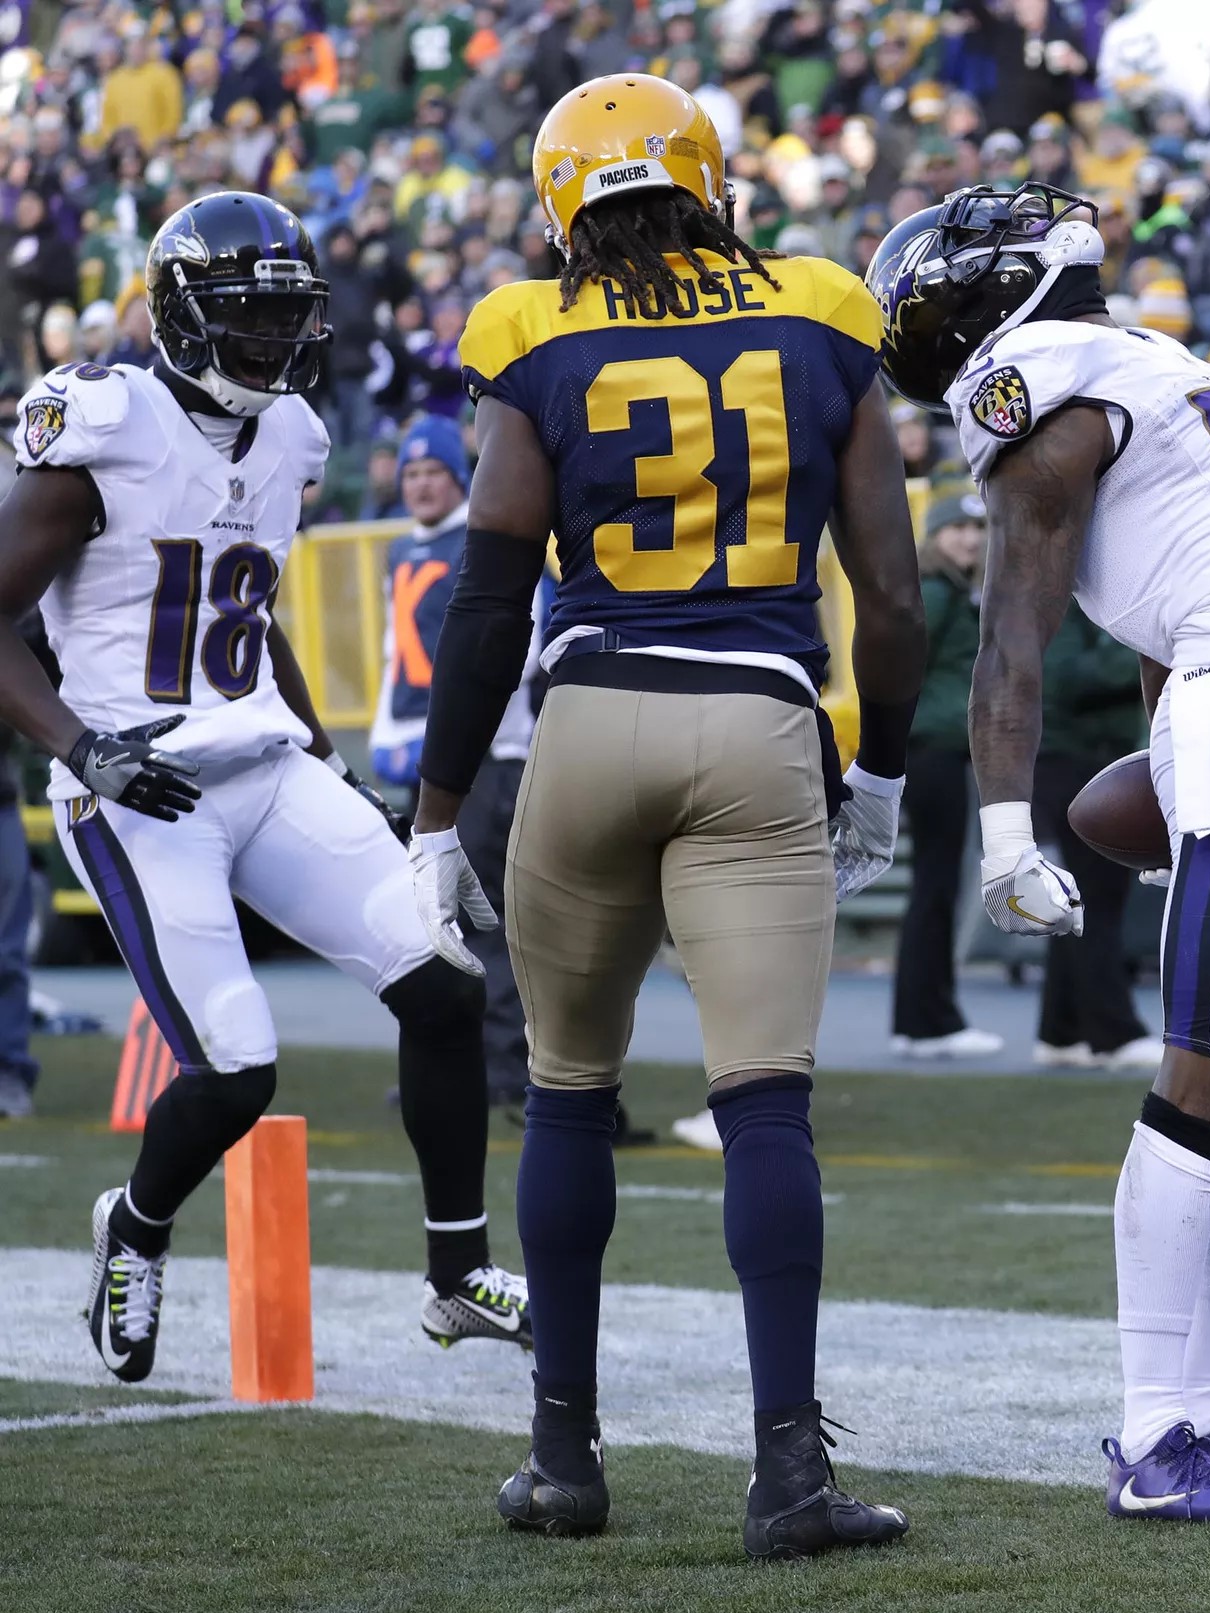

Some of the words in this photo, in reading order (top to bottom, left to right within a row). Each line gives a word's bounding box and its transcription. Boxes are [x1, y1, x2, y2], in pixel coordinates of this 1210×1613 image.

[649, 145, 664, 155] NFL
[599, 164, 649, 187] PACKERS
[602, 267, 766, 320] HOUSE
[28, 398, 63, 410] RAVENS
[971, 368, 1013, 405] RAVENS
[585, 349, 800, 592] 31
[210, 520, 254, 532] RAVENS
[144, 538, 279, 705] 18
[392, 560, 450, 688] K
